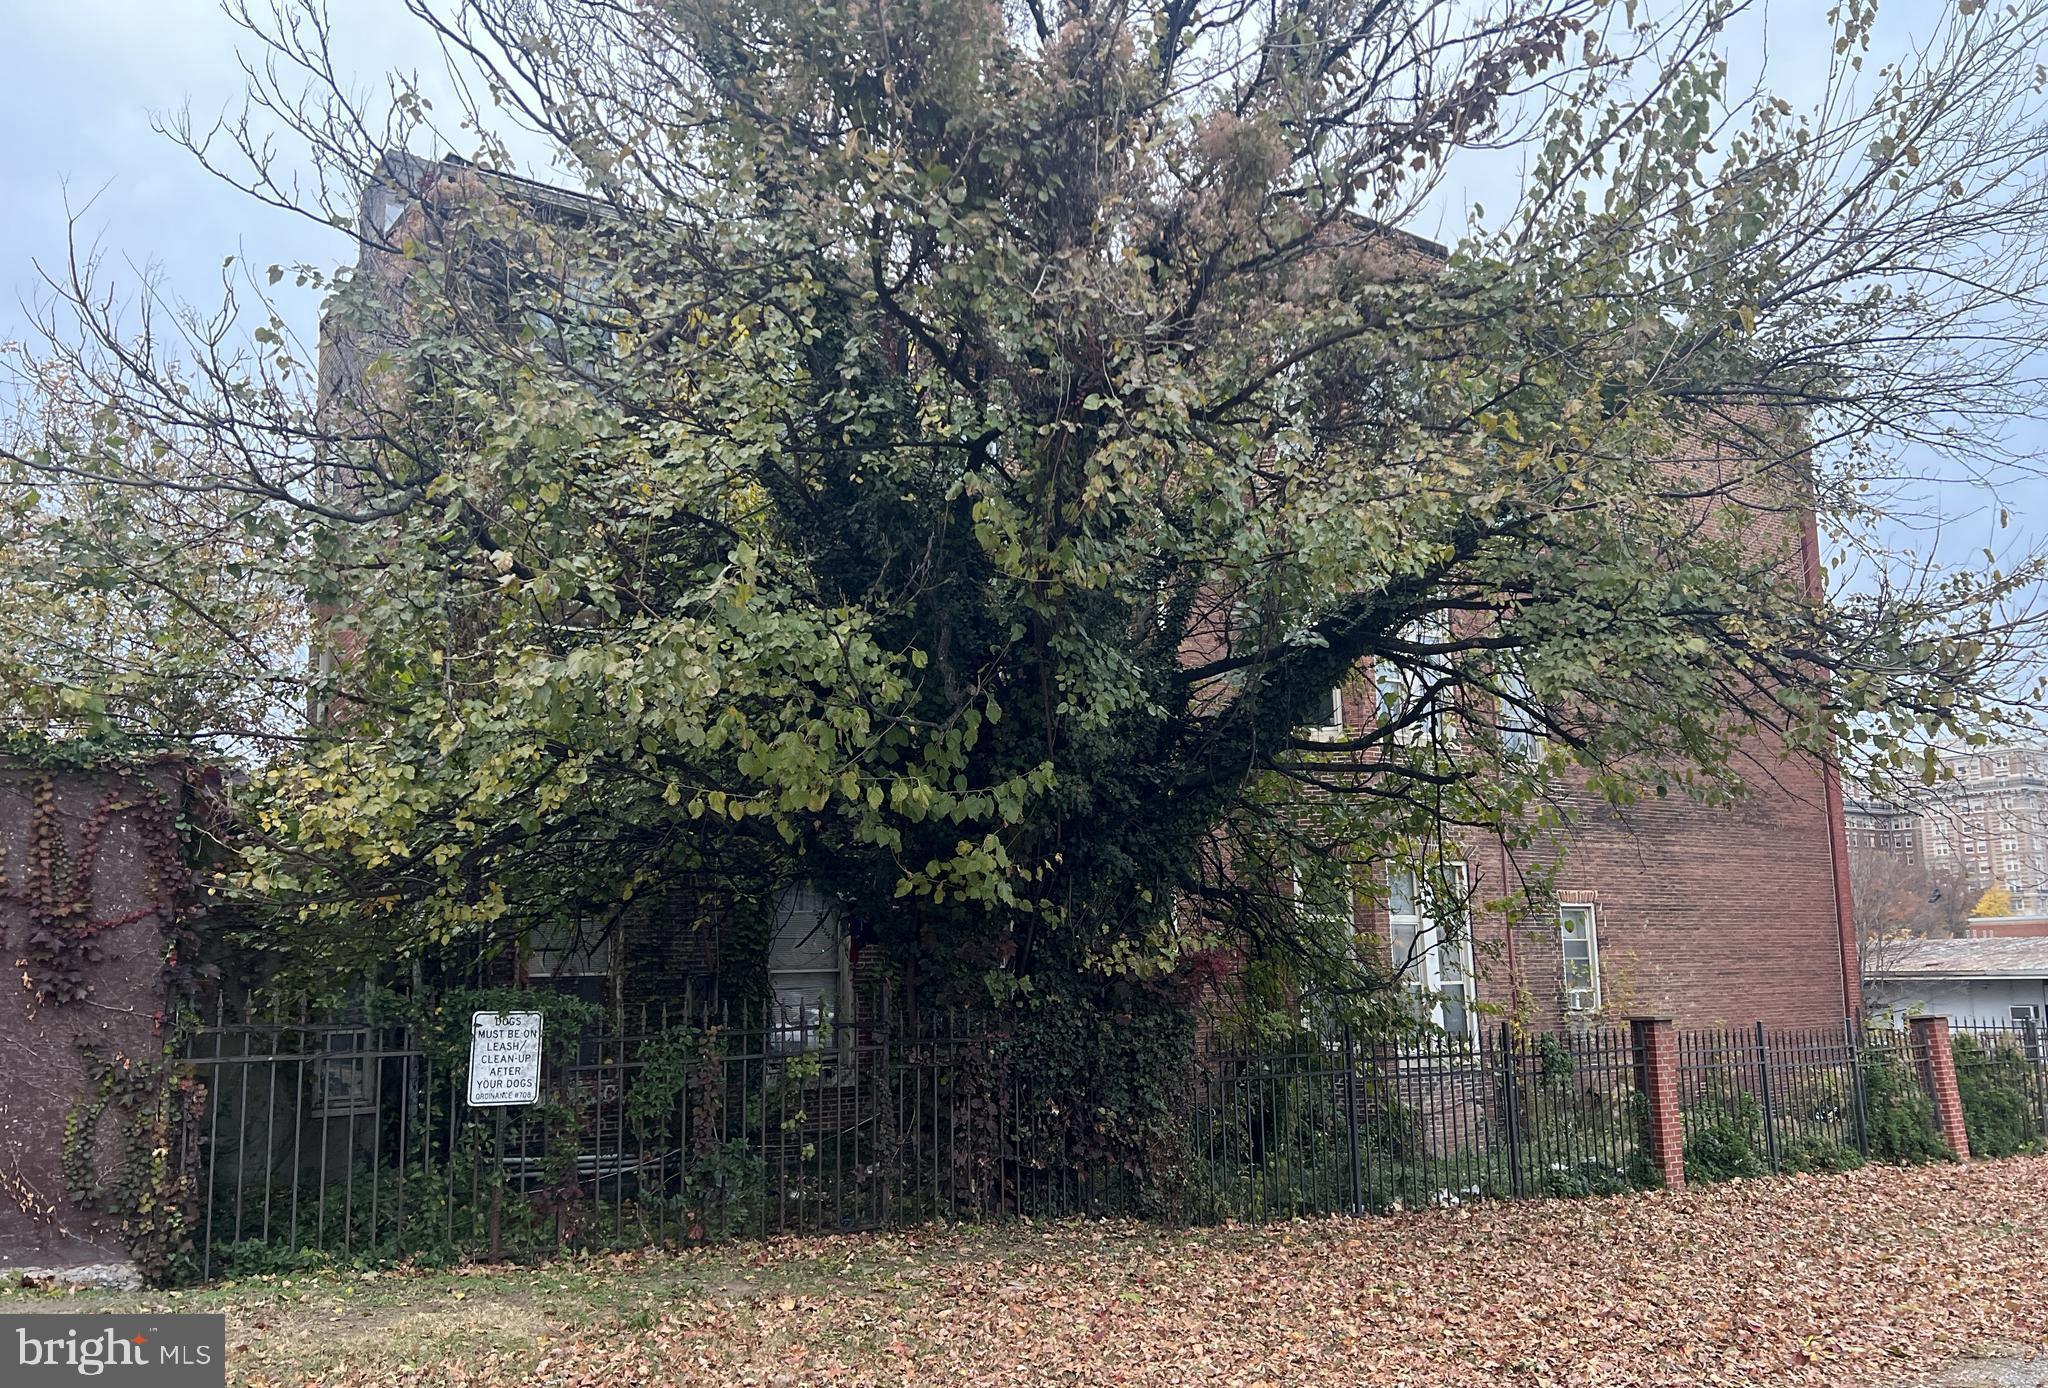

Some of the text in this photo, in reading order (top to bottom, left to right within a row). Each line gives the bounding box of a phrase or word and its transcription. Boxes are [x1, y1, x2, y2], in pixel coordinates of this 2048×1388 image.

[495, 1017, 521, 1026] DOGS
[478, 1030, 537, 1038] MUST BE ON
[487, 1040, 527, 1052] LEASH/
[481, 1054, 531, 1063] CLEAN-UP
[489, 1067, 521, 1076] AFTER
[477, 1079, 533, 1089] YOUR DOGS
